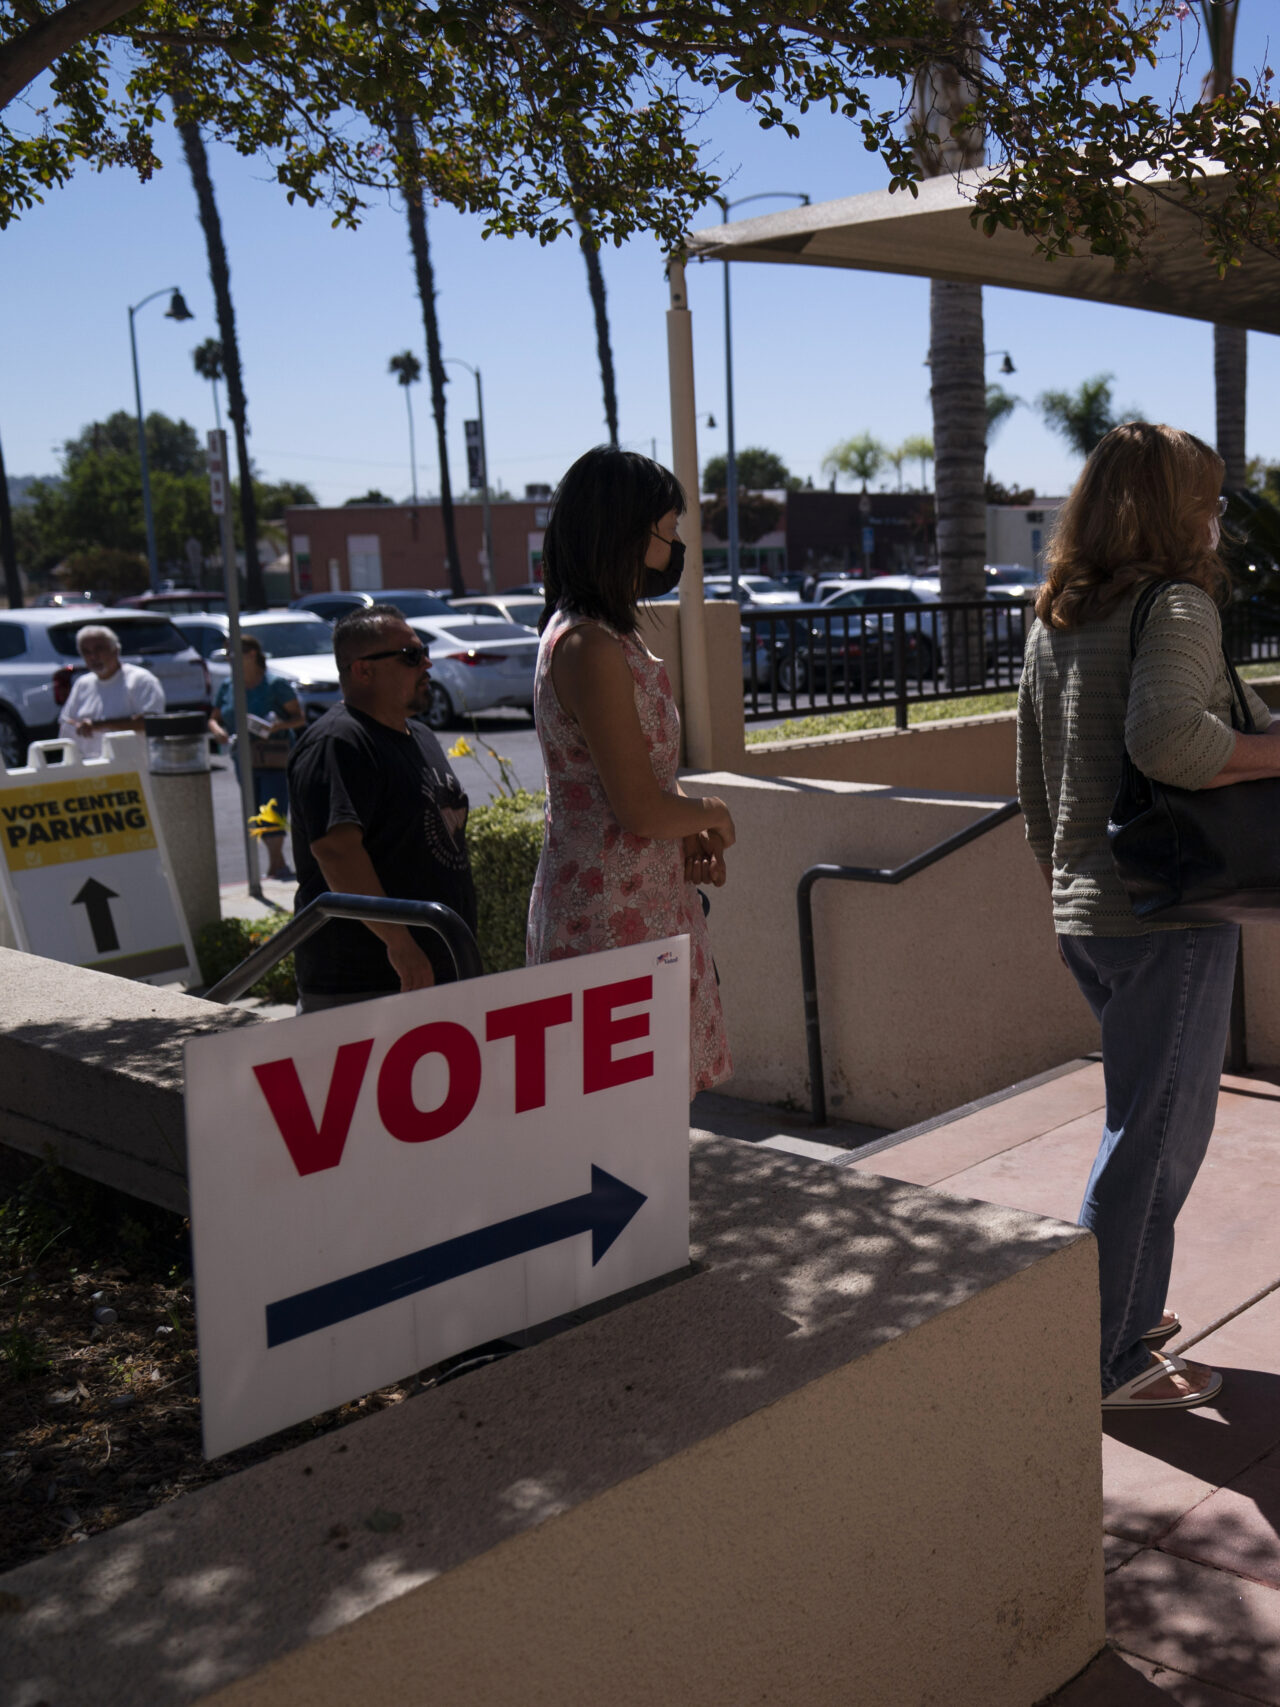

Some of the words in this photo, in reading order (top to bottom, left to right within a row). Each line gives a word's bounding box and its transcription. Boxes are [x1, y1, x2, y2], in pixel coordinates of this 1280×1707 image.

[1, 801, 60, 822] VOTE
[64, 790, 139, 813] CENTER
[6, 808, 147, 848] PARKING
[252, 975, 654, 1177] VOTE
